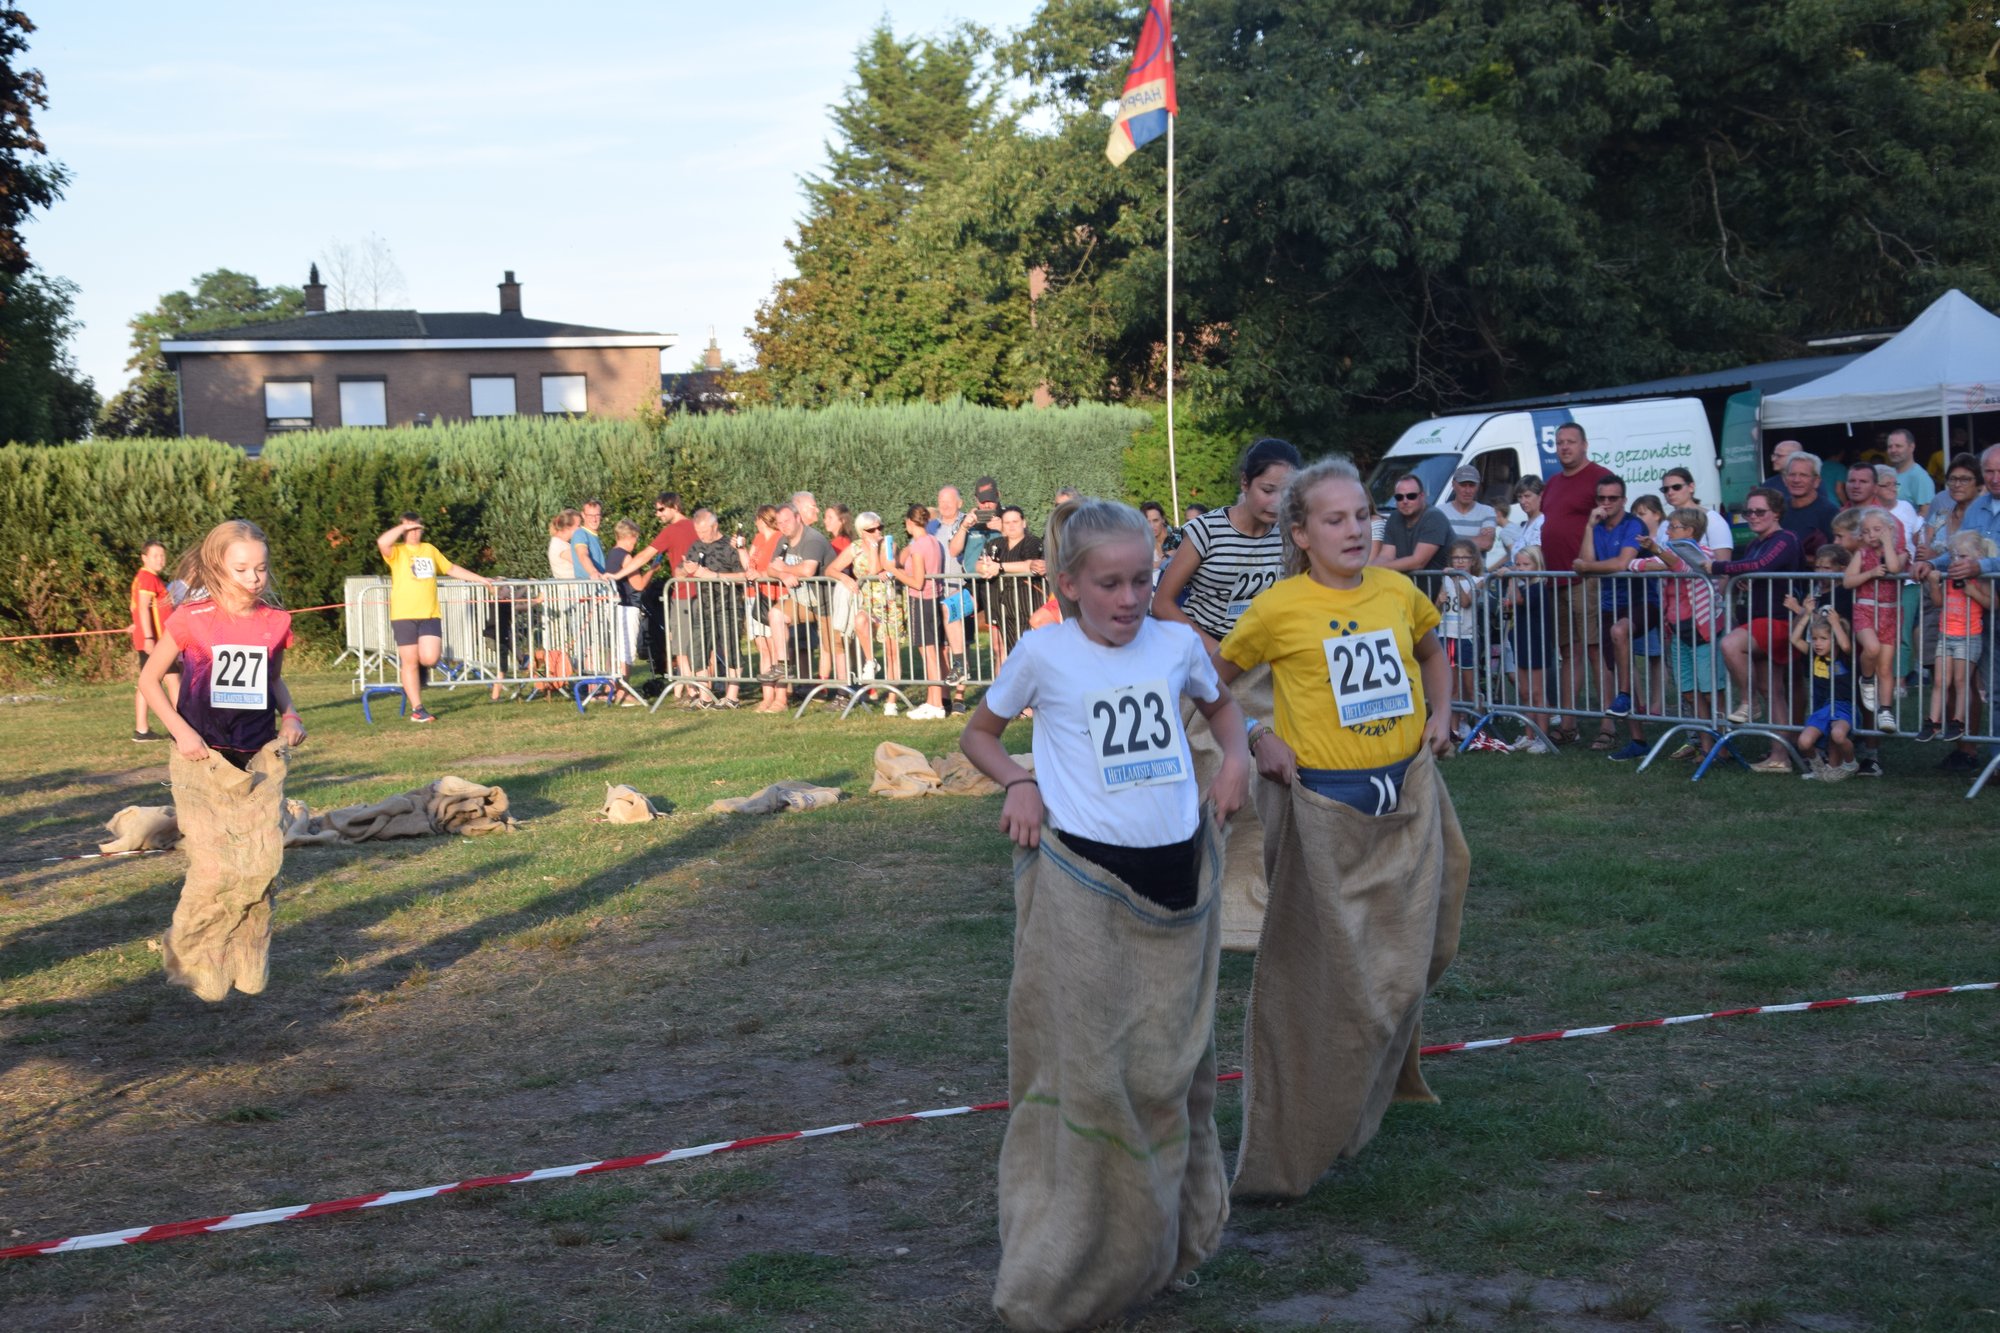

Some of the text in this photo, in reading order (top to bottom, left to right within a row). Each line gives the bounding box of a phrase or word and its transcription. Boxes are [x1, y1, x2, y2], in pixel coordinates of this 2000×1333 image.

[1592, 442, 1692, 468] De gezondste
[416, 559, 432, 571] 391
[215, 650, 263, 687] 227
[1333, 638, 1401, 696] 225
[1344, 704, 1358, 719] HET
[1383, 696, 1406, 711] NIEUWS
[1093, 692, 1171, 757] 223
[1107, 760, 1178, 783] HET LAATSTE NIEUWS
